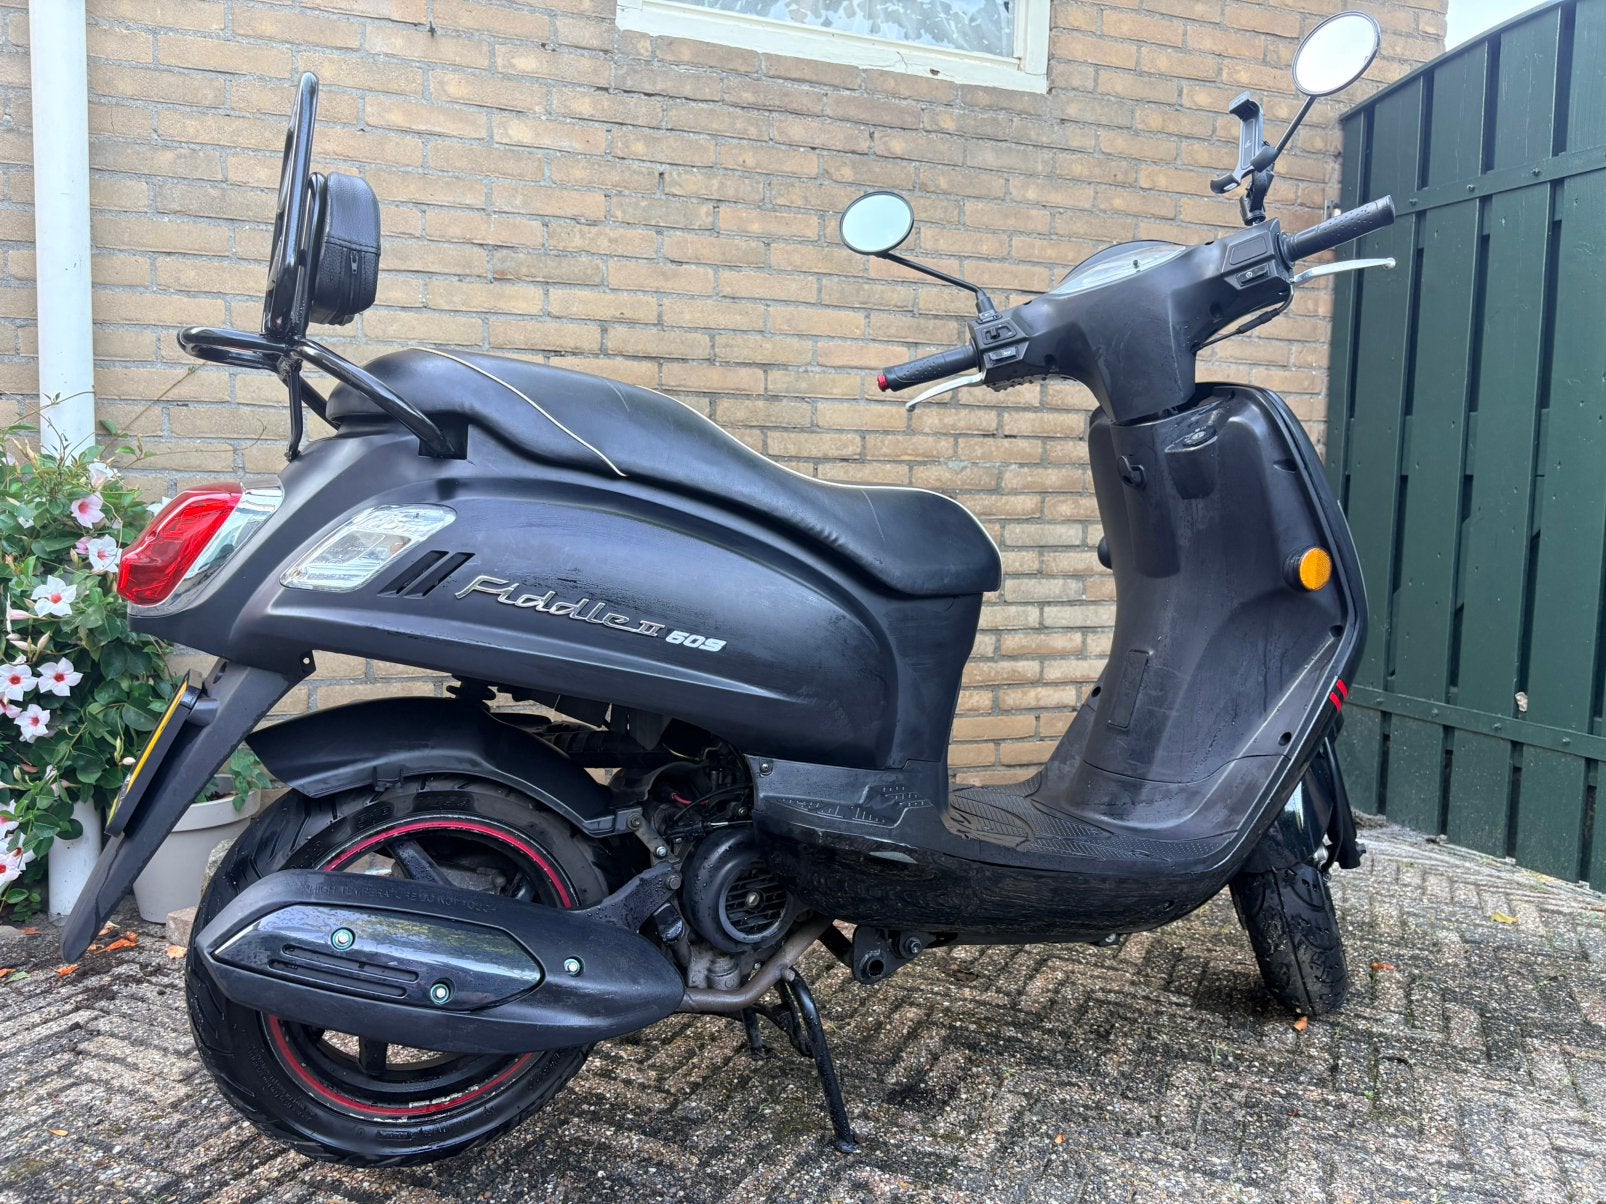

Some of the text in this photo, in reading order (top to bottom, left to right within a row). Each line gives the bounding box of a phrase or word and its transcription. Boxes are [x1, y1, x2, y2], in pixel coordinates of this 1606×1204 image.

[454, 575, 639, 633] Fiddle
[638, 620, 666, 637] II
[313, 884, 336, 896] HIGH
